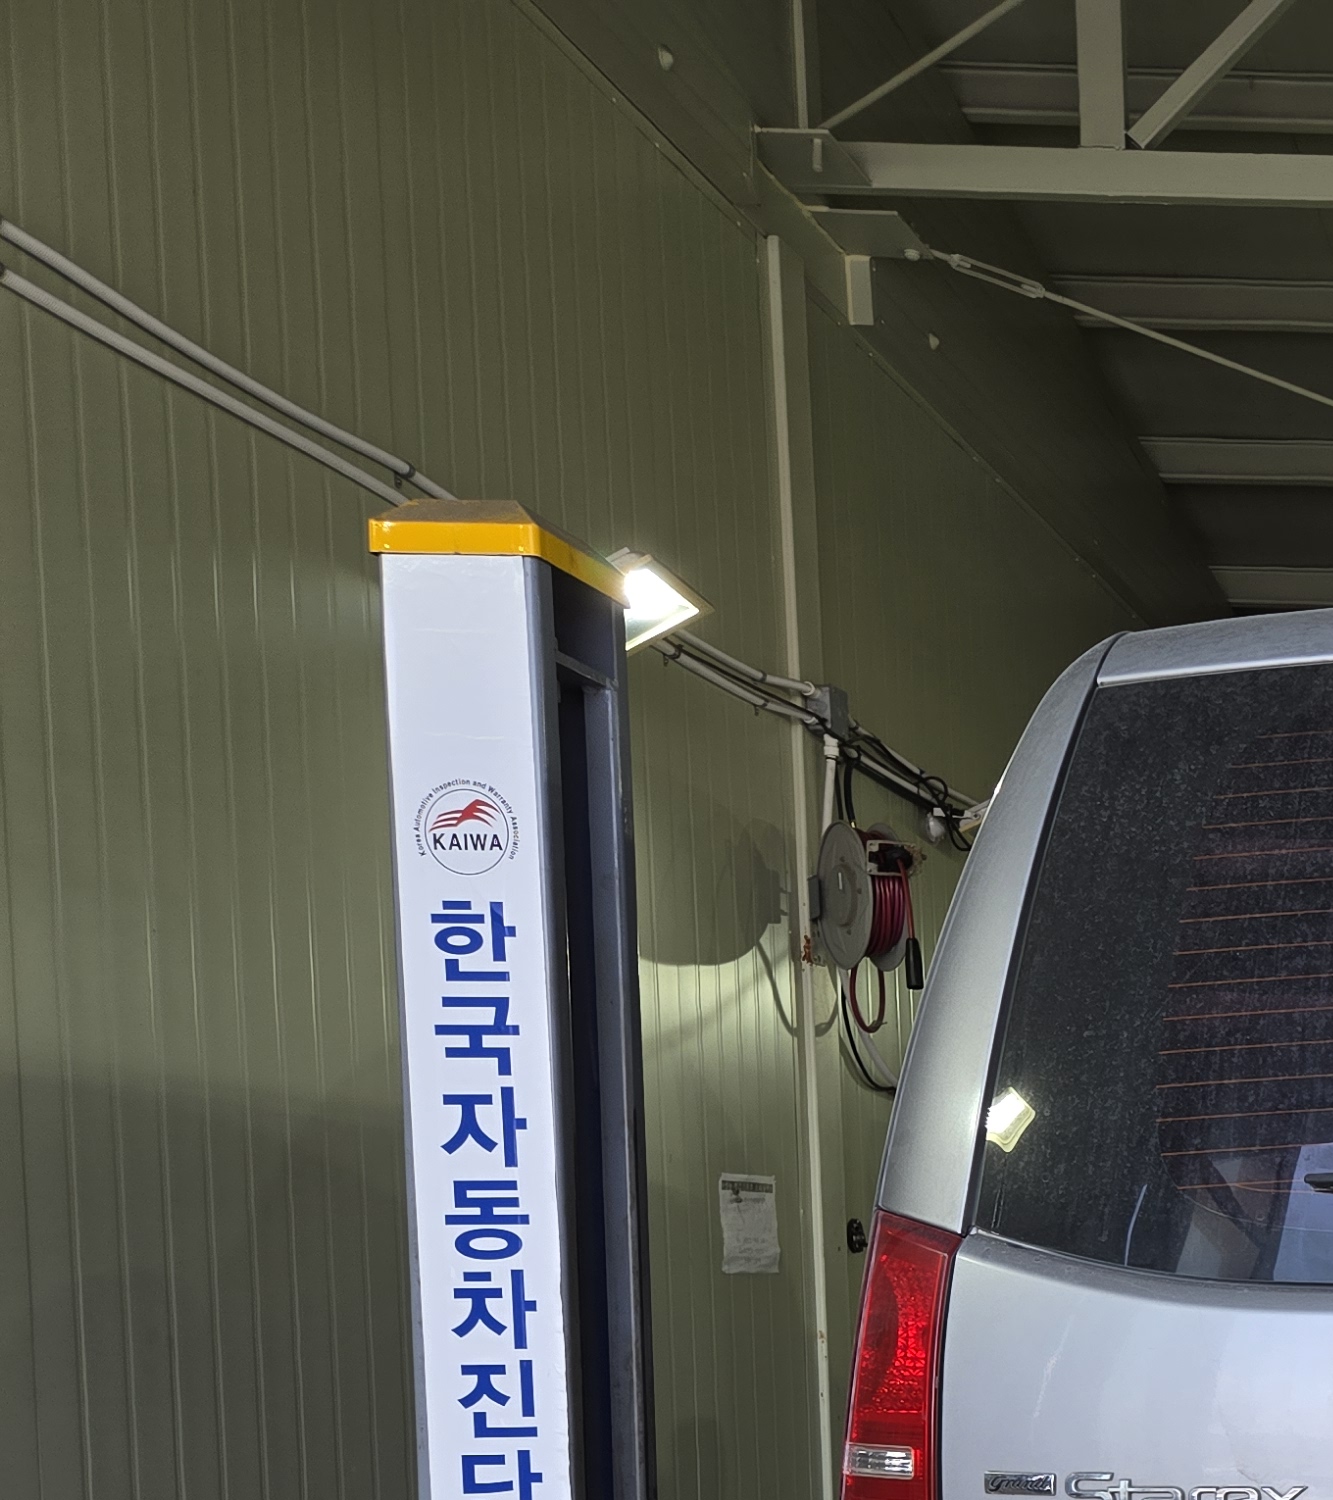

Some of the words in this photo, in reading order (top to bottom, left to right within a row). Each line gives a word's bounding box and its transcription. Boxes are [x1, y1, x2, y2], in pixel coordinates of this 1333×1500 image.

[432, 778, 471, 794] Inspection
[472, 780, 487, 790] and
[487, 785, 514, 814] Warranty
[413, 793, 434, 832] Automotive
[415, 834, 427, 857] Korea
[432, 833, 503, 851] KAIWA
[508, 816, 520, 860] Association
[986, 1474, 1053, 1493] Grand
